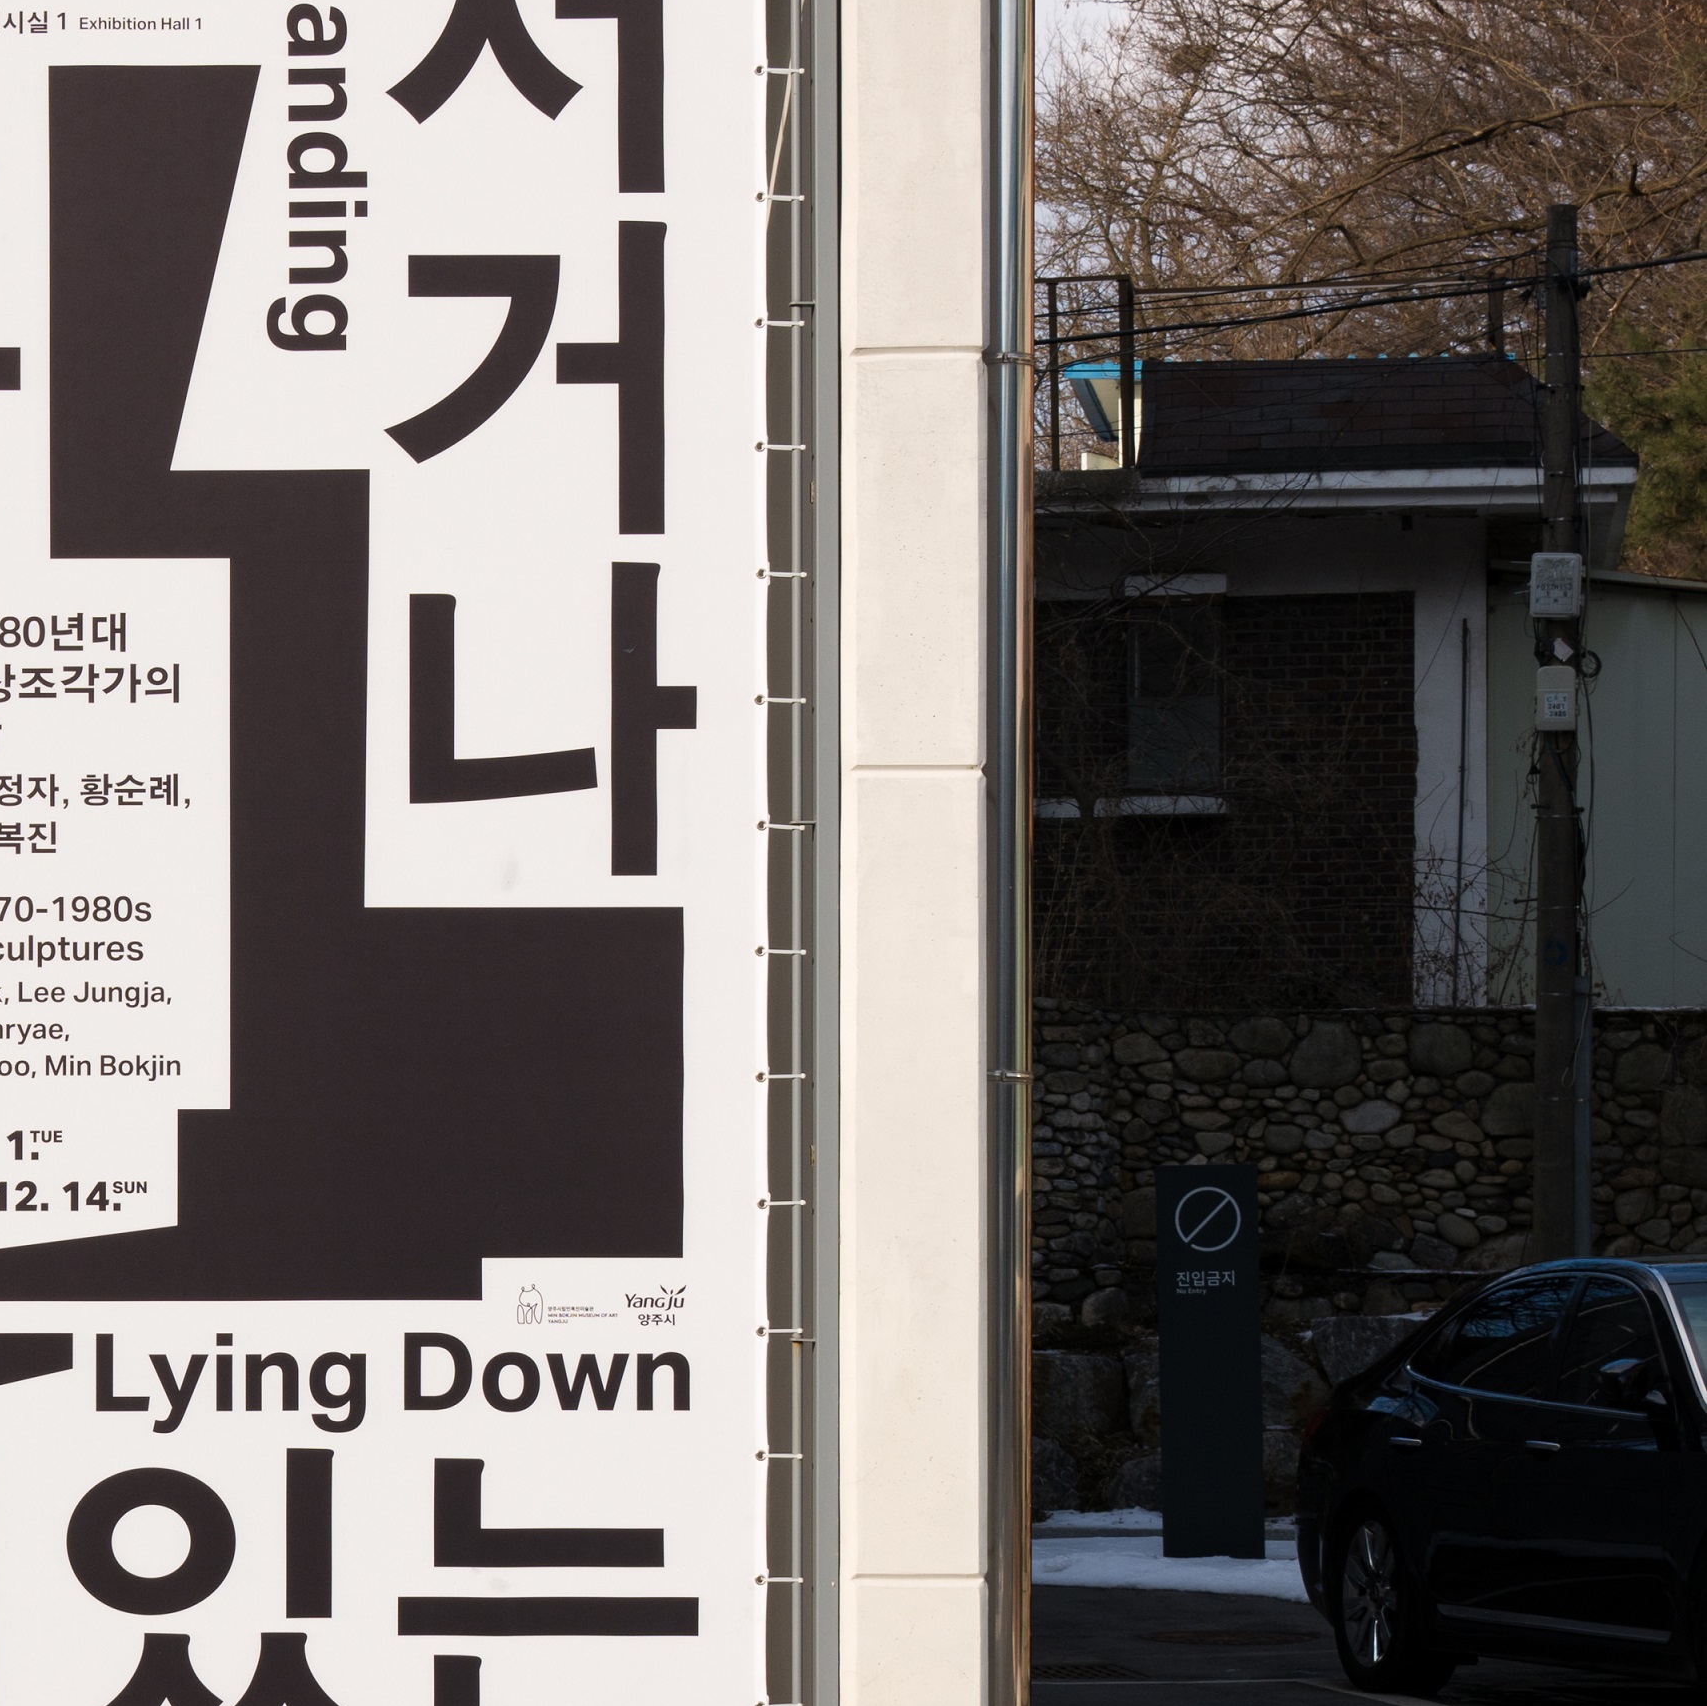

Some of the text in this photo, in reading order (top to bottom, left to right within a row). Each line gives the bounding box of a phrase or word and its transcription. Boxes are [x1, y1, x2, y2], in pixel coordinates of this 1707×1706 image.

[57, 12, 66, 30] 1
[79, 16, 157, 31] Exhibition
[161, 17, 190, 31] Hall
[195, 17, 202, 30] 1
[81, 774, 190, 809] 황순례,
[19, 982, 65, 1002] Lee
[74, 982, 171, 1008] Jungja,
[46, 1055, 91, 1075] Min
[101, 1055, 180, 1081] Bokjin
[1176, 1270, 1236, 1287] 진입금지
[1187, 1287, 1207, 1295] Entry
[637, 1313, 676, 1327] 양주시
[96, 1333, 690, 1433] Lying Down
